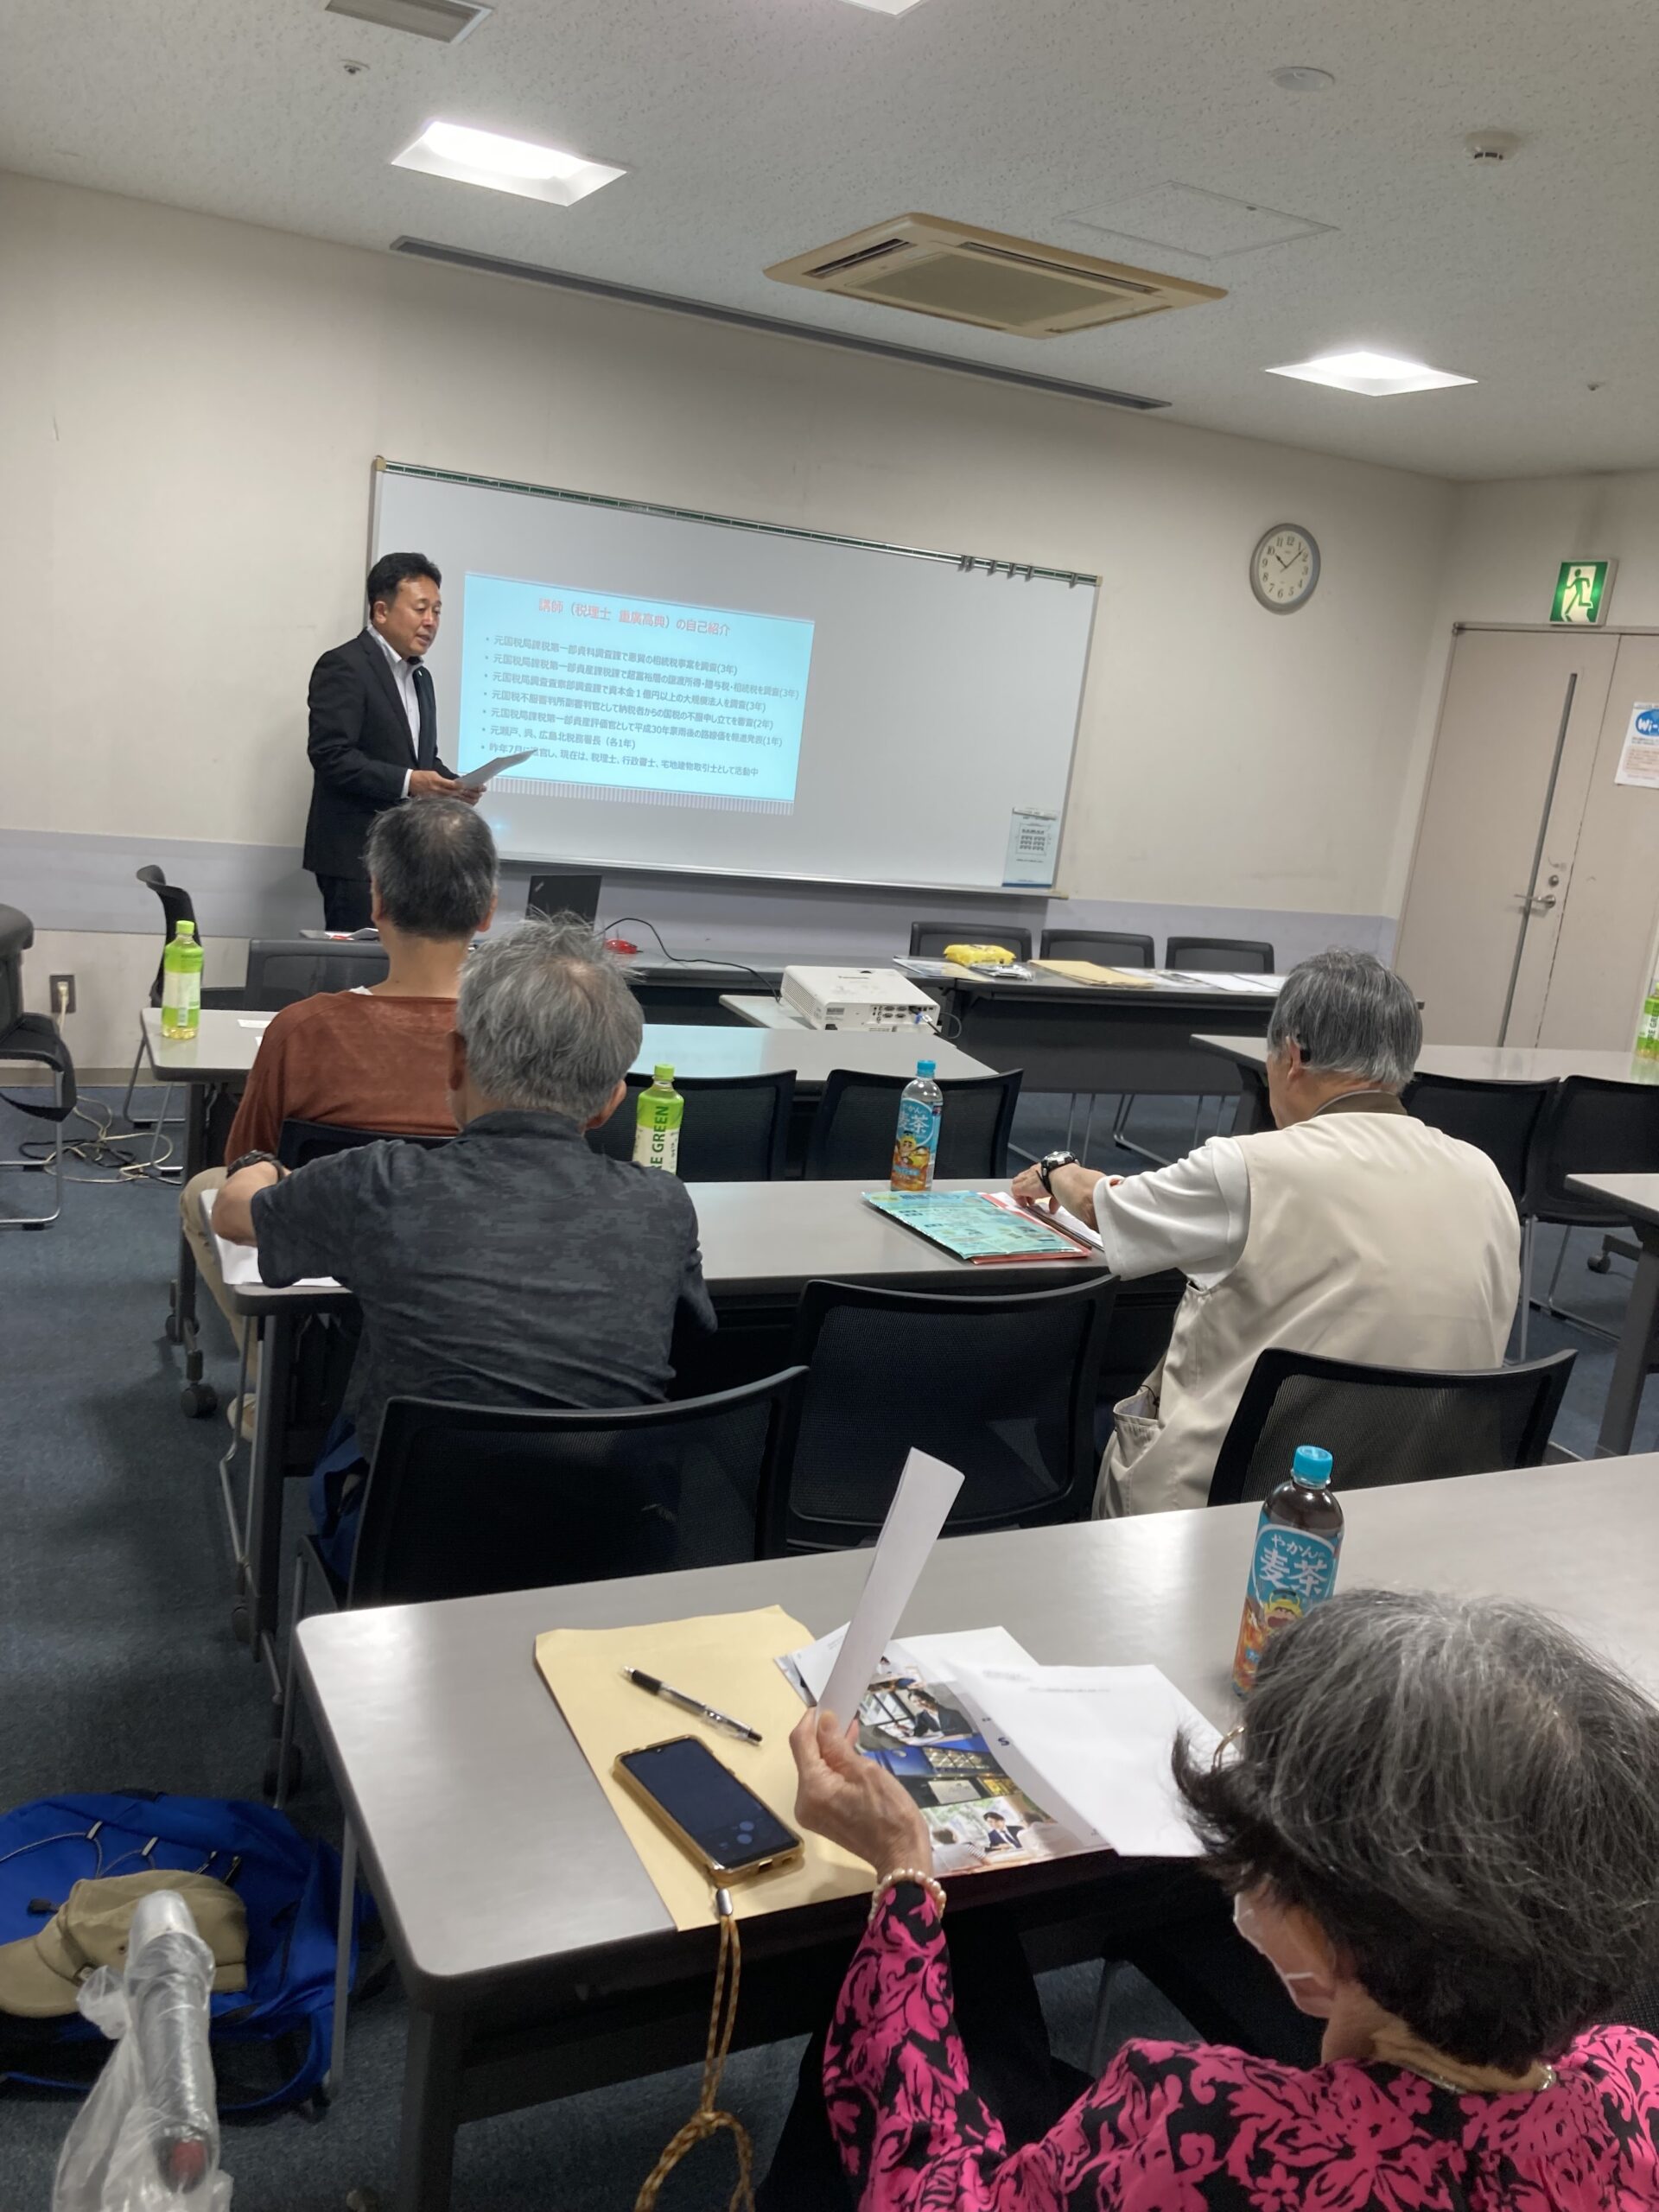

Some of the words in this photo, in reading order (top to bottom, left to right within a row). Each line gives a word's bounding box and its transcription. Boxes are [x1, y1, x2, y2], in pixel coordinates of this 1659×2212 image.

[1276, 537, 1284, 547] 11
[1287, 536, 1294, 546] 12
[1268, 545, 1275, 556] 10
[1262, 558, 1268, 568] 9
[1262, 572, 1268, 582] 8
[1269, 582, 1275, 593] 7
[1277, 588, 1284, 598] 6
[1638, 718, 1659, 733] Wi-
[652, 1106, 670, 1153] GREEN
[1259, 1546, 1328, 1597] 麦茶
